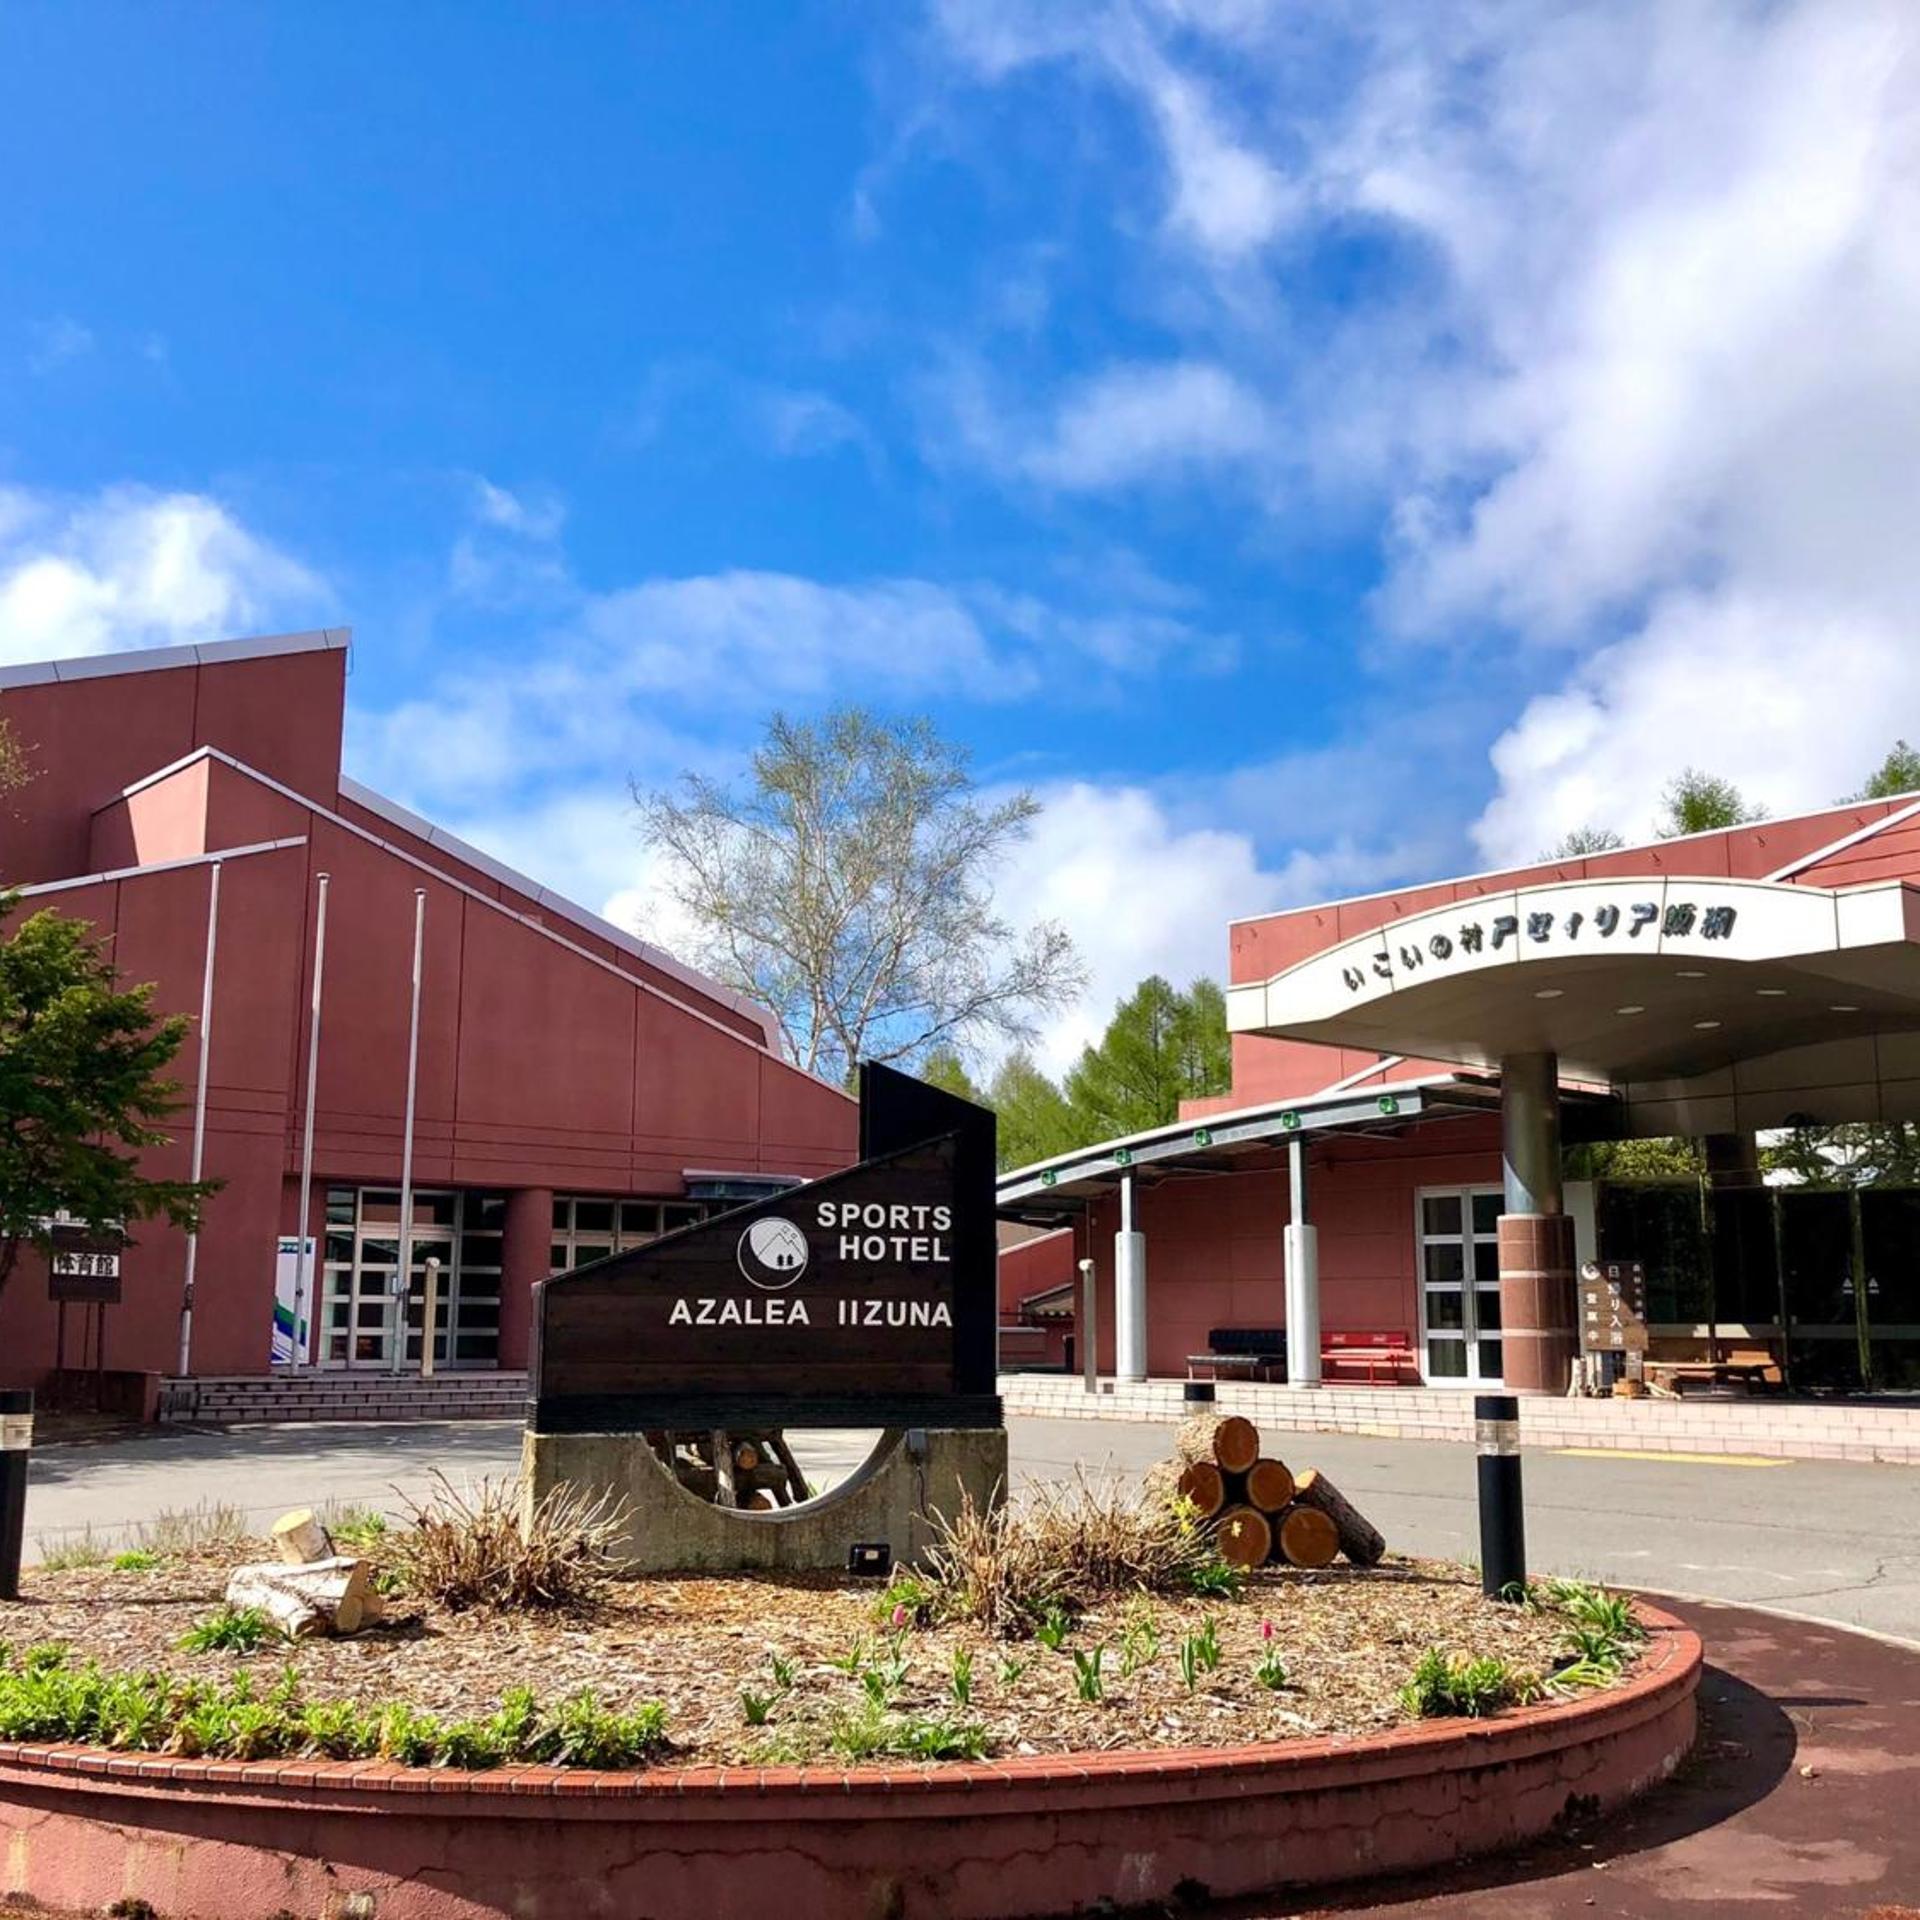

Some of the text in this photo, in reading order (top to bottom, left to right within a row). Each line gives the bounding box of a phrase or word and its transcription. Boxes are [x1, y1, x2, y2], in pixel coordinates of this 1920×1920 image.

[817, 1202, 952, 1231] SPORTS
[839, 1235, 951, 1262] HOTEL
[57, 1254, 114, 1276] 体育館
[668, 1299, 952, 1327] AZALEA IIZUNA
